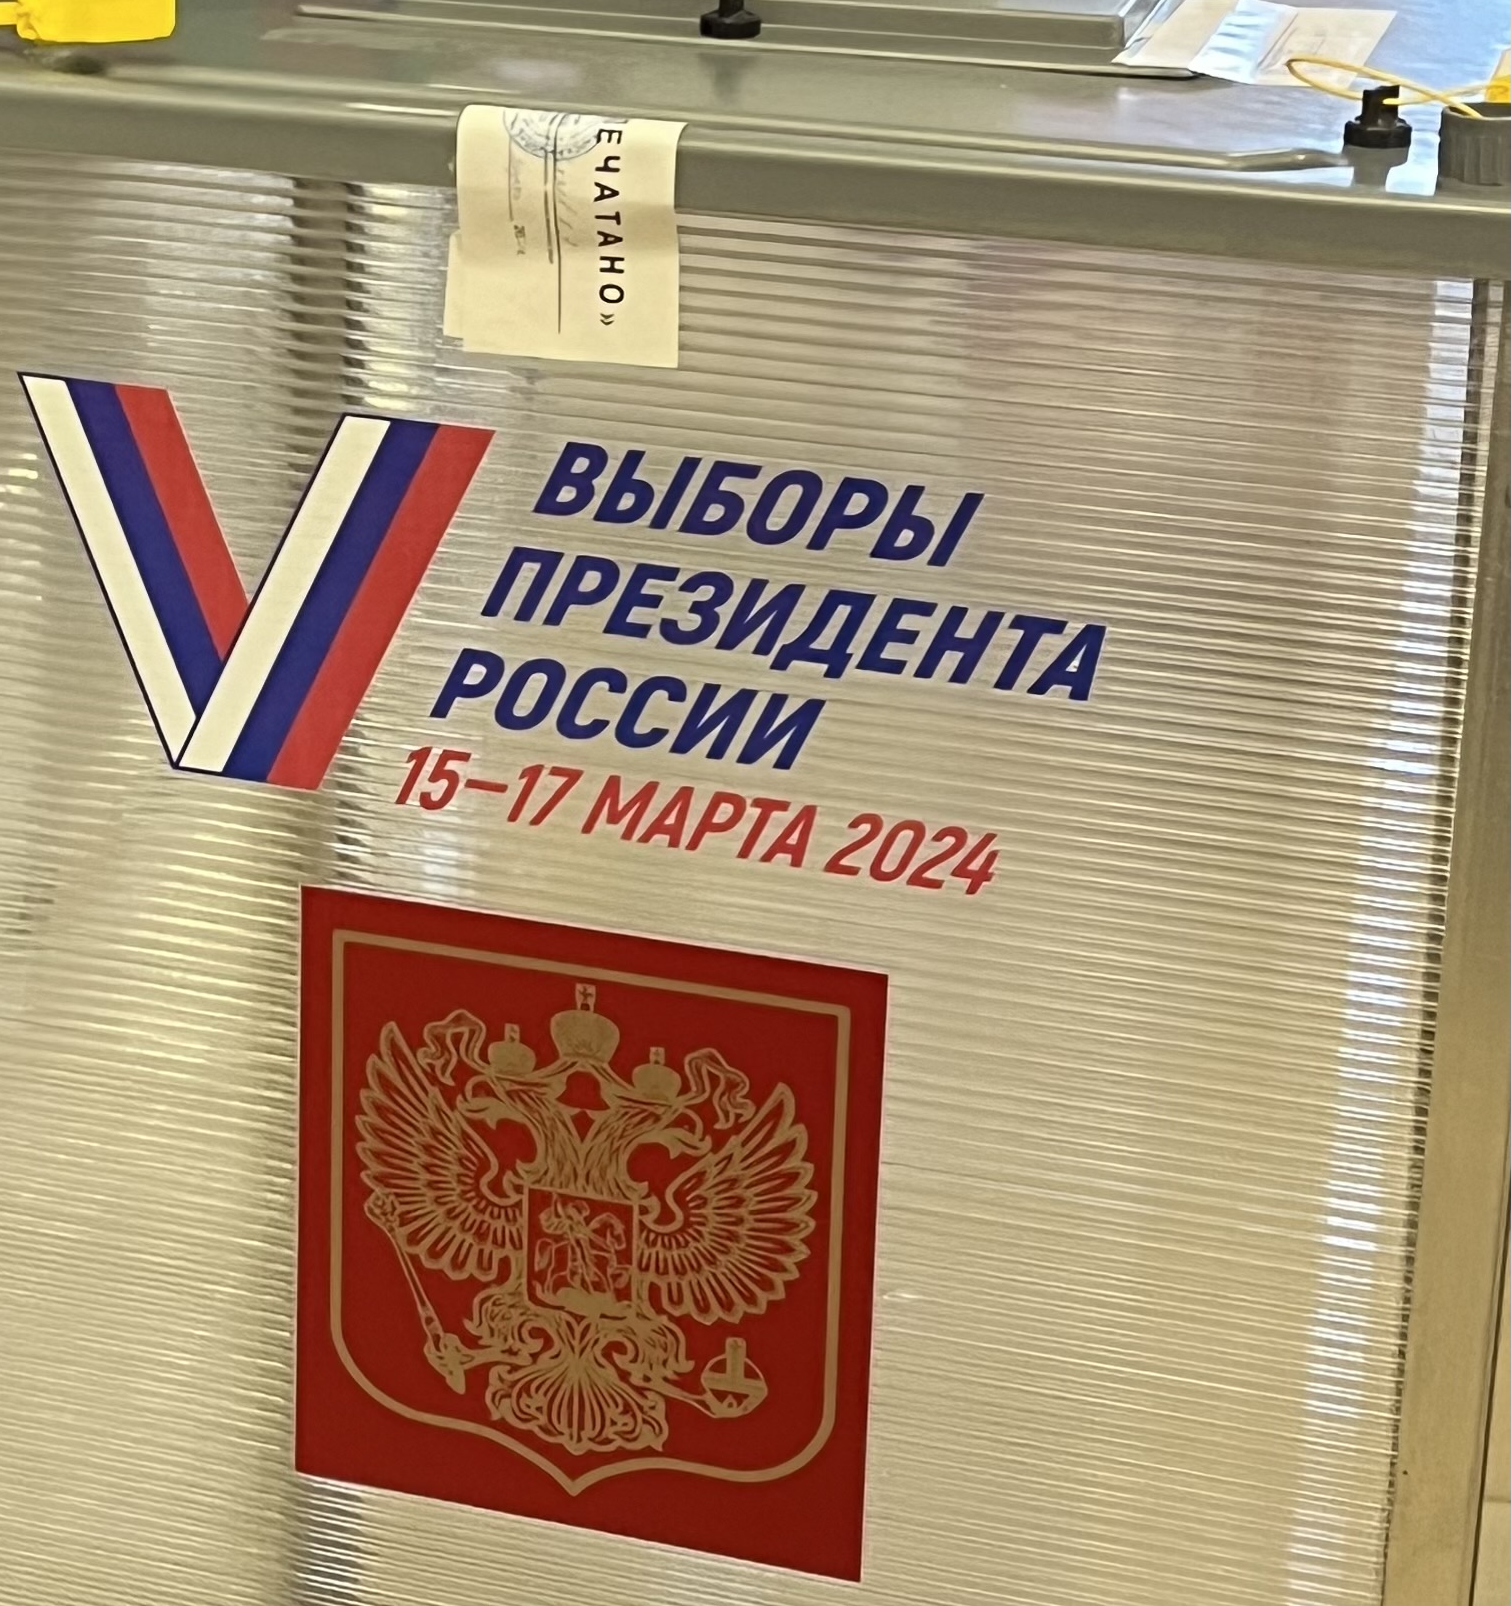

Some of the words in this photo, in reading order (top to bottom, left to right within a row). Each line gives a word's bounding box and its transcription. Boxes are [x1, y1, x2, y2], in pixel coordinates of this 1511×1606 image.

[593, 121, 626, 326] ЕЧАТАНО»
[535, 443, 980, 566] ВЫБОРЫ
[484, 547, 1105, 701] ПРЕЗИДЕНТА
[433, 650, 824, 769] РОССИИ
[582, 776, 818, 868] МАРТА
[826, 813, 998, 896] 2024
